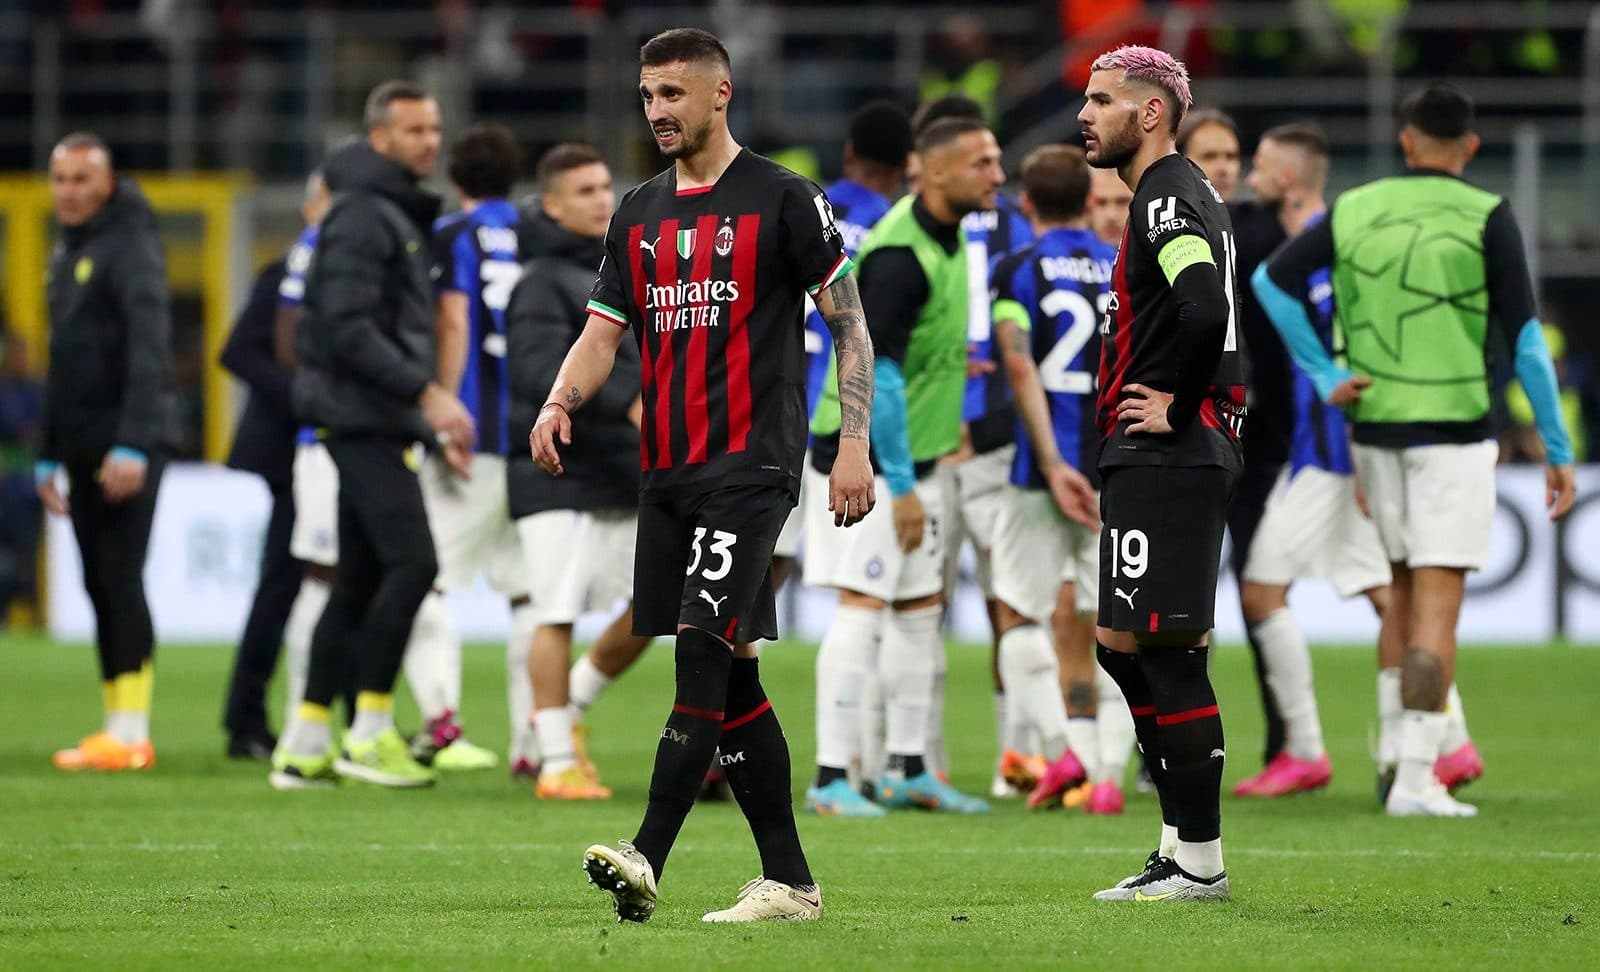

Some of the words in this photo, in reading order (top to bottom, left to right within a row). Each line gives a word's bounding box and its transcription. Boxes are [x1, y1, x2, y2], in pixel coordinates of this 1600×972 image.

[1147, 218, 1189, 243] BitMEX
[645, 277, 740, 309] Emirates
[655, 311, 673, 333] FLY
[686, 526, 737, 581] 33
[1110, 528, 1149, 579] 19
